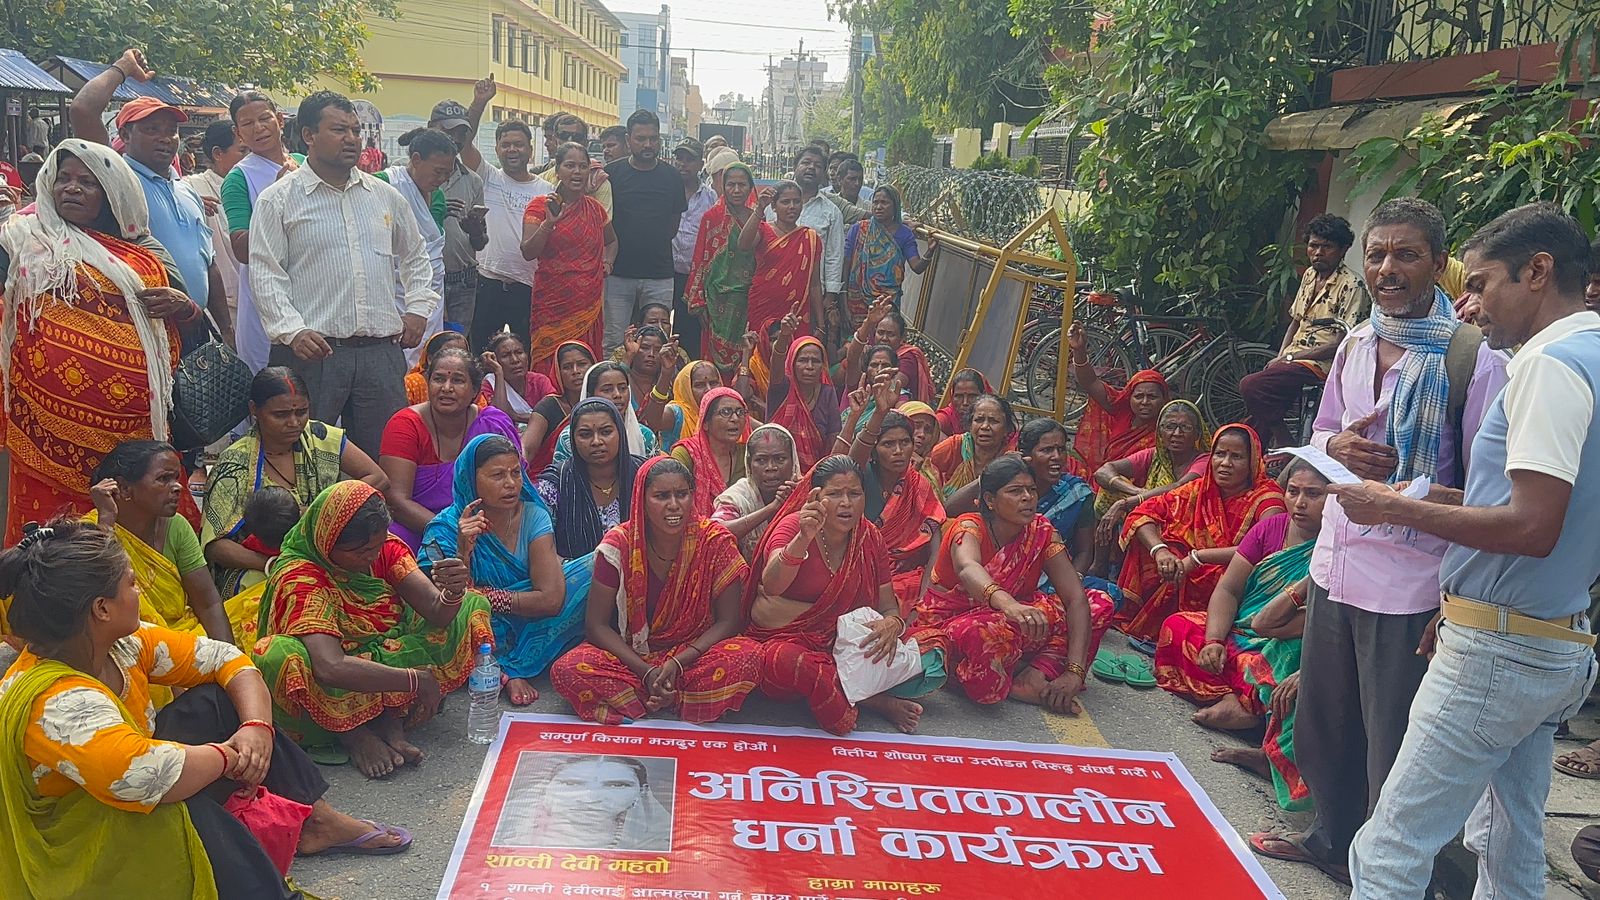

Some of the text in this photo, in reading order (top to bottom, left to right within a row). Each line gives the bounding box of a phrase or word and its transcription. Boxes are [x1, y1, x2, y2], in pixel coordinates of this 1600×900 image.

[591, 732, 645, 745] किसान
[701, 739, 729, 750] एक
[882, 749, 928, 762] शोषण
[931, 753, 964, 765] तथा
[1077, 763, 1116, 775] संघर्ष
[732, 816, 1165, 875] धर्ना कार्यक्रम
[485, 853, 671, 874] शान्ती देवी महतो
[507, 882, 555, 894] शान्ती
[562, 883, 626, 897] देवीलाई
[631, 886, 710, 900] आत्महत्या
[807, 877, 855, 890] हाम्रा
